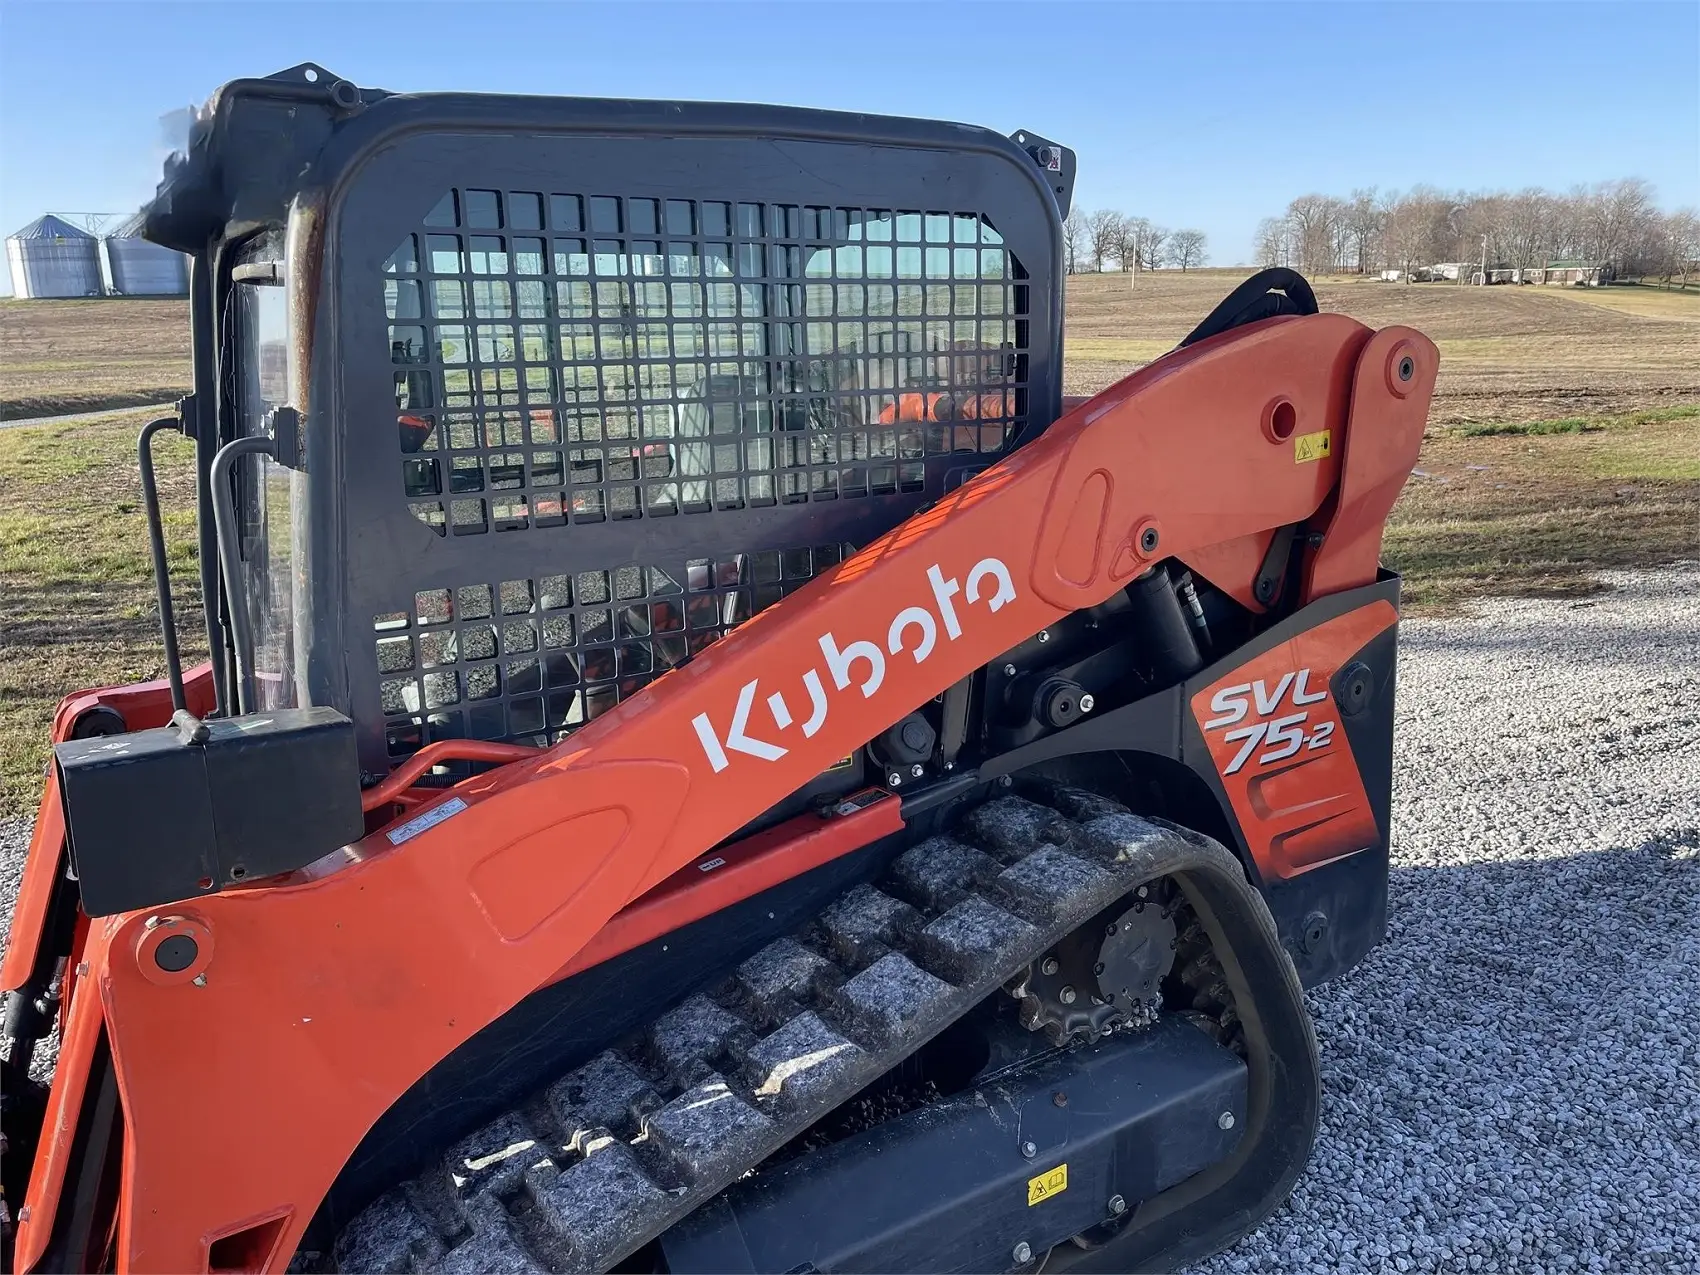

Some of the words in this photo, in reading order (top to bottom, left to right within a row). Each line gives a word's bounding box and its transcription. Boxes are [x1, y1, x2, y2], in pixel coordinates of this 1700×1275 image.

[691, 557, 1017, 774] Kubota
[1204, 668, 1328, 730] SVL
[1222, 711, 1335, 776] 75-2
